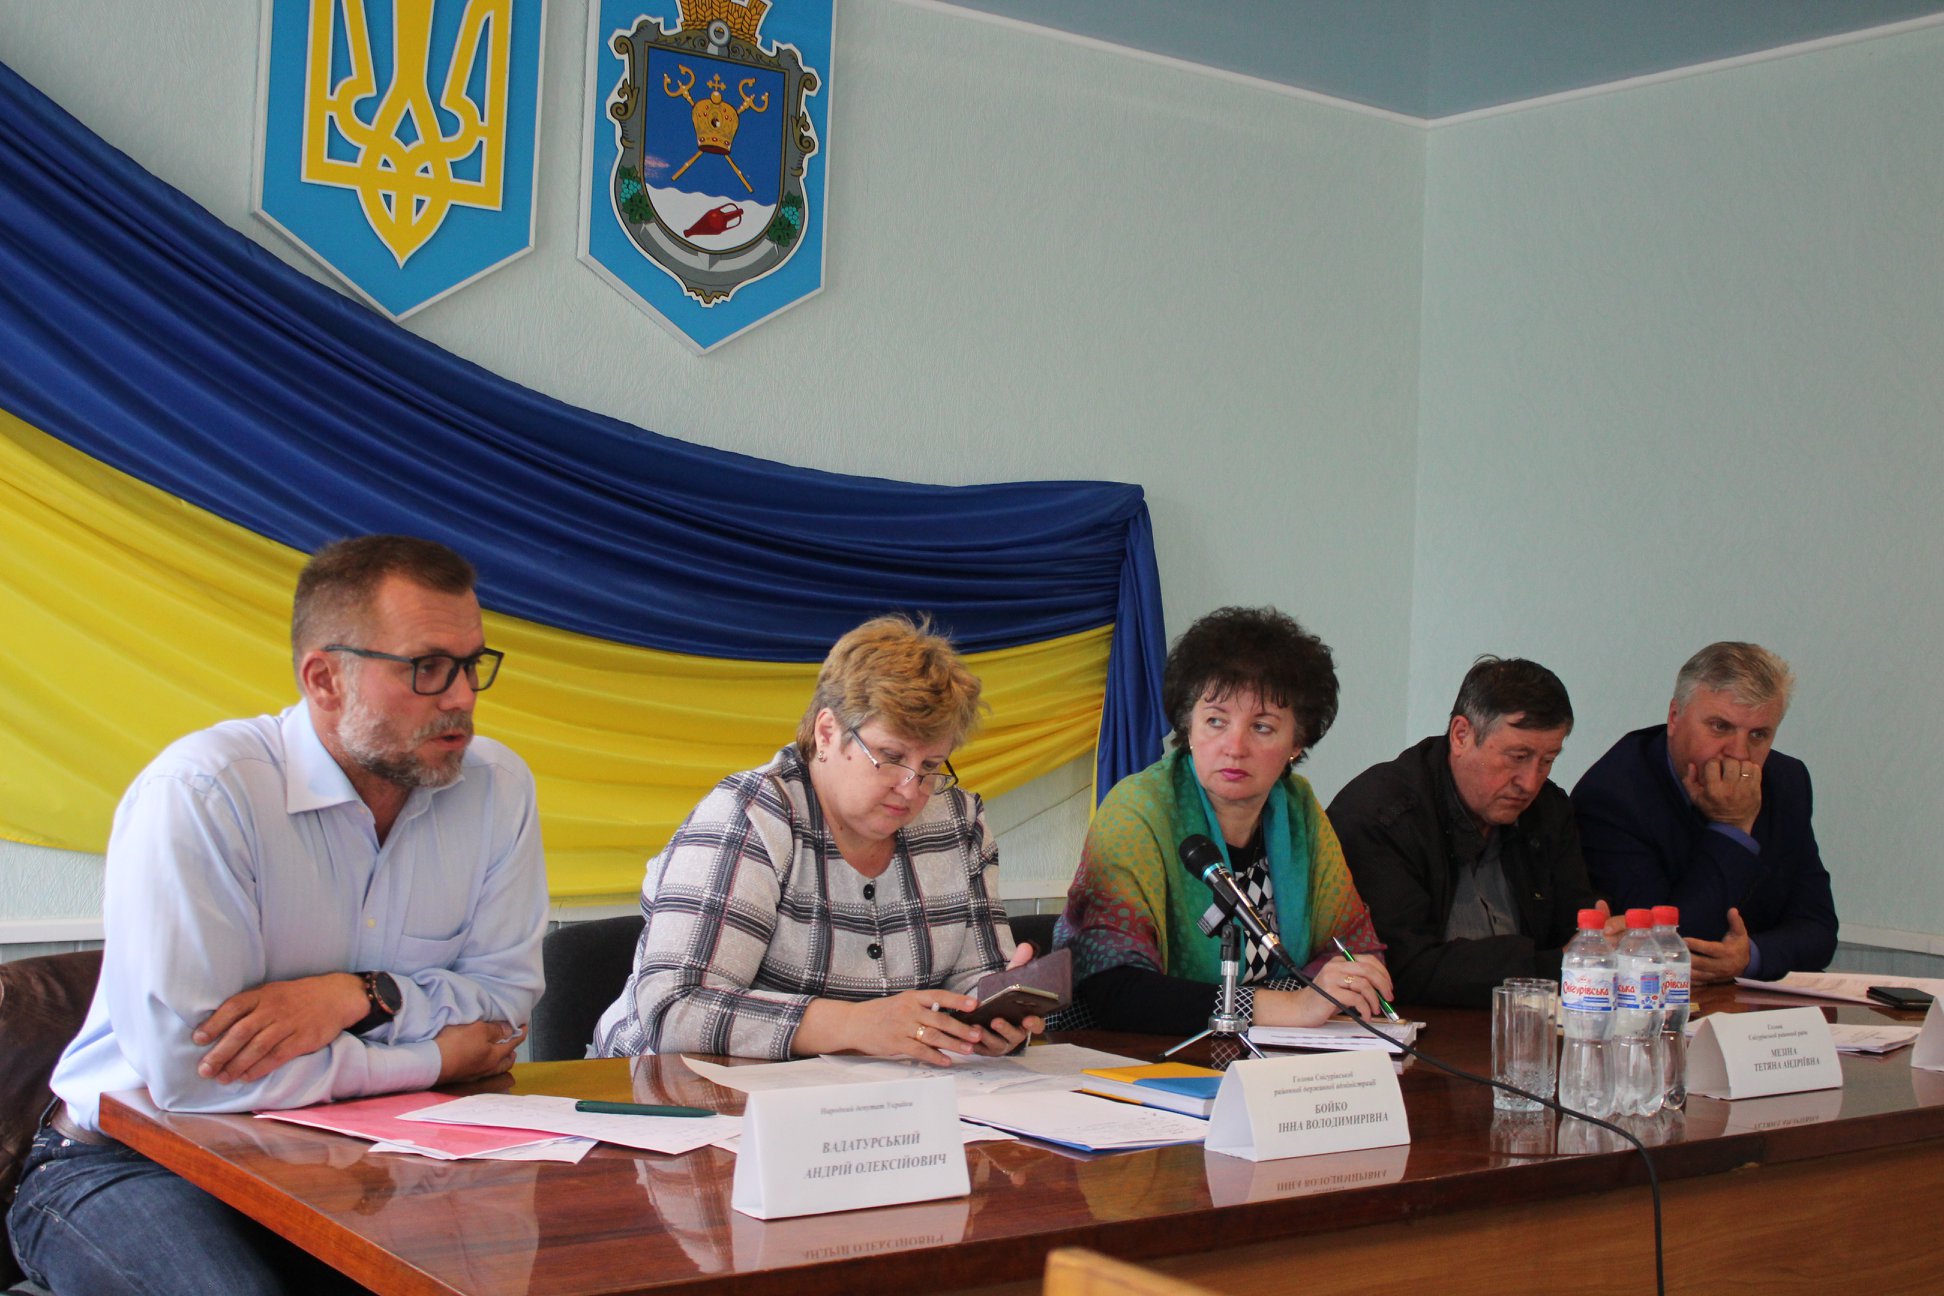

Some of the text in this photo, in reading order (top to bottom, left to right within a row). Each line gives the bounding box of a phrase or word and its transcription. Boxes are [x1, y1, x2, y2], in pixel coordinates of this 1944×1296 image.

[1754, 1056, 1820, 1072] ТЕТЯНА АНДРІЇВНА
[1315, 1101, 1348, 1114] БОЙКО
[1278, 1112, 1389, 1133] ІННА ВОЛОДИМИРІВНА
[804, 1153, 947, 1180] АНДРІЙ ОЛЕКСІЙОВИЧ
